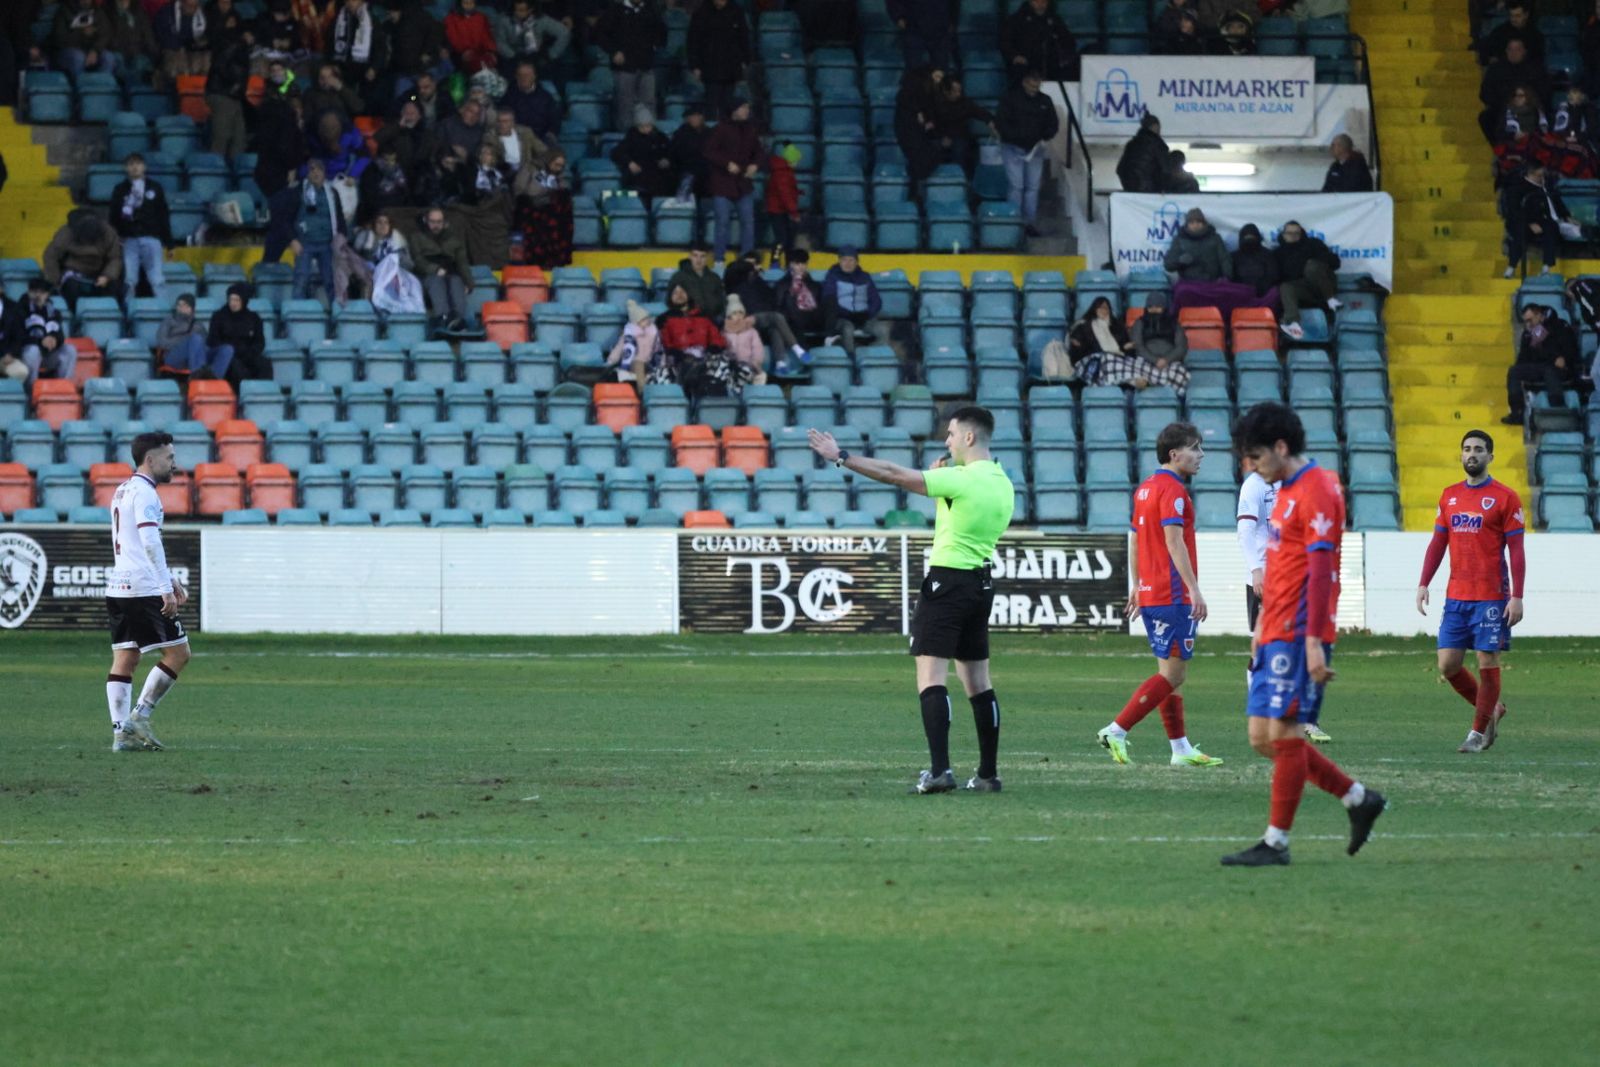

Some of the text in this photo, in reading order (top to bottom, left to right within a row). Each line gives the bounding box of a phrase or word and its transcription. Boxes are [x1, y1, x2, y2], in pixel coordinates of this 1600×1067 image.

[1158, 78, 1309, 98] MINIMARKET
[1174, 102, 1294, 113] MIRANDA DE AZAN
[1328, 244, 1386, 259] fianza!
[1451, 513, 1483, 529] DPM
[692, 536, 888, 553] CUADRA TORBLAZ
